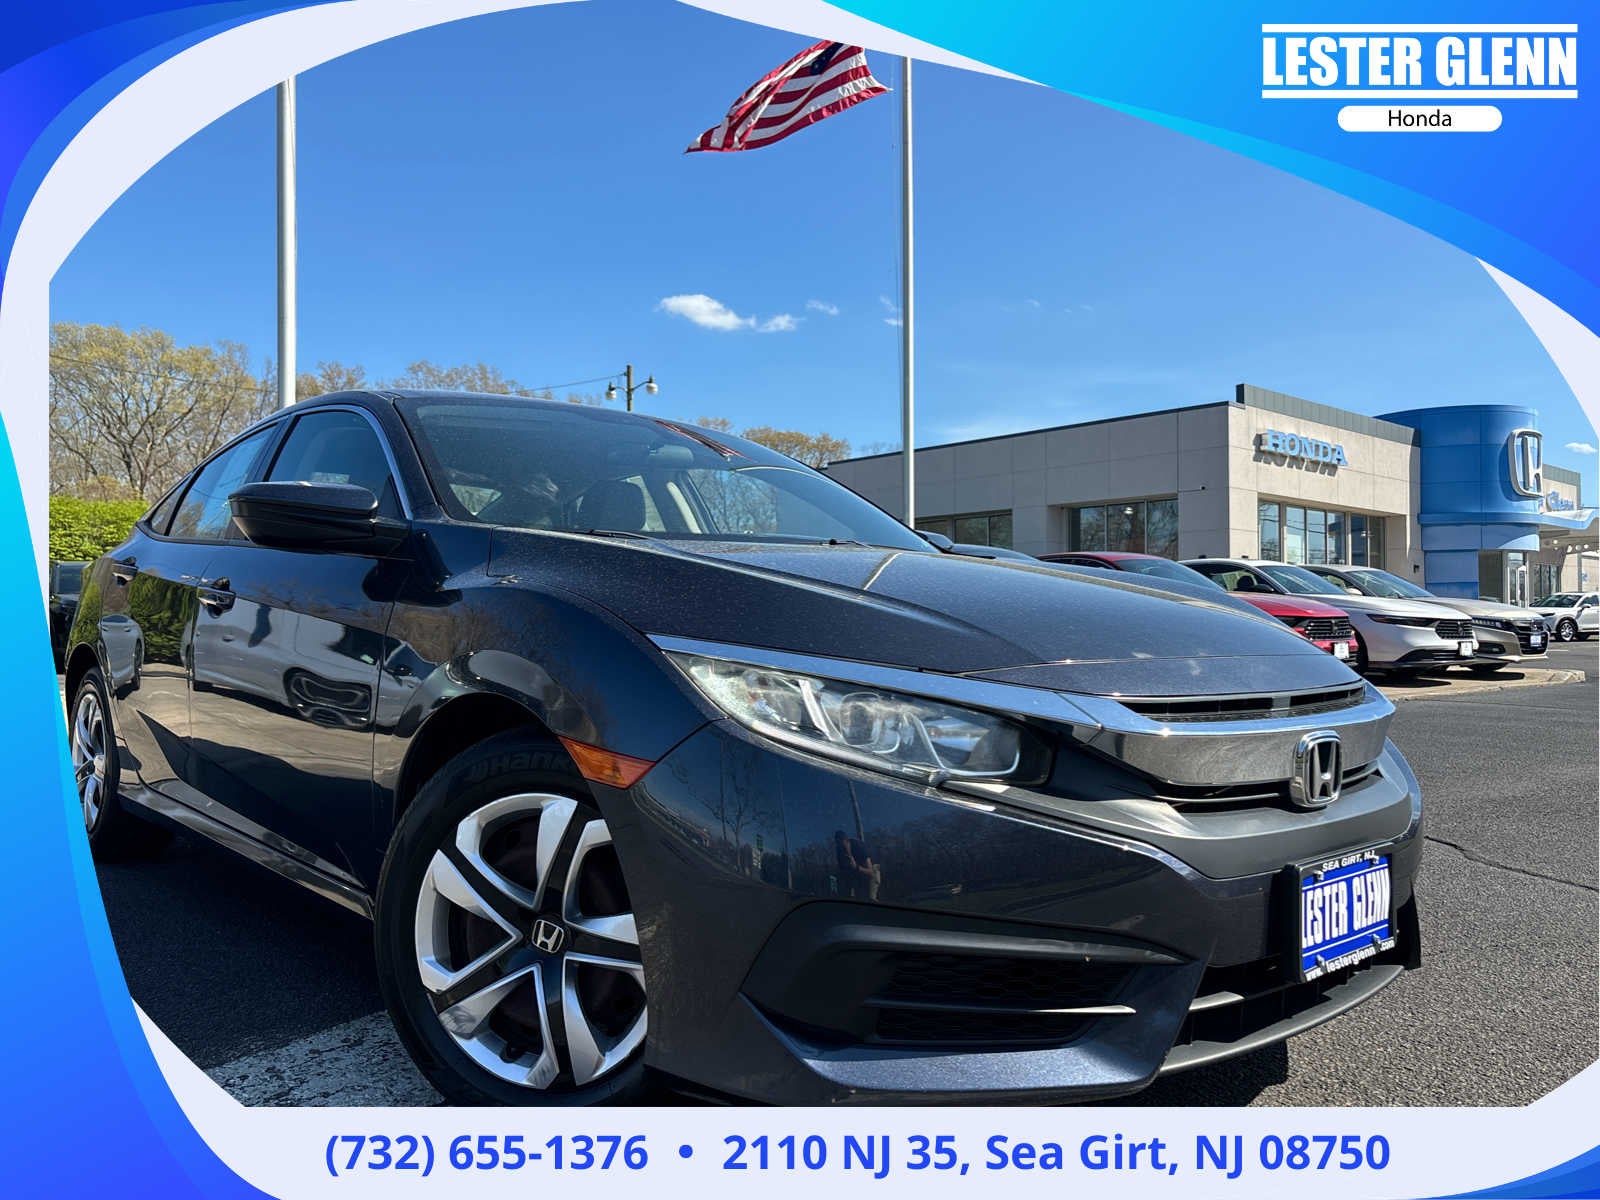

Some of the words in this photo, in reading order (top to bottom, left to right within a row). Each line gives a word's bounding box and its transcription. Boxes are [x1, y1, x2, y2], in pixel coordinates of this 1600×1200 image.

[1266, 429, 1348, 467] HONDA
[1322, 862, 1340, 872] SEA
[1302, 880, 1348, 949] LESTER
[1352, 867, 1389, 931] GLENN
